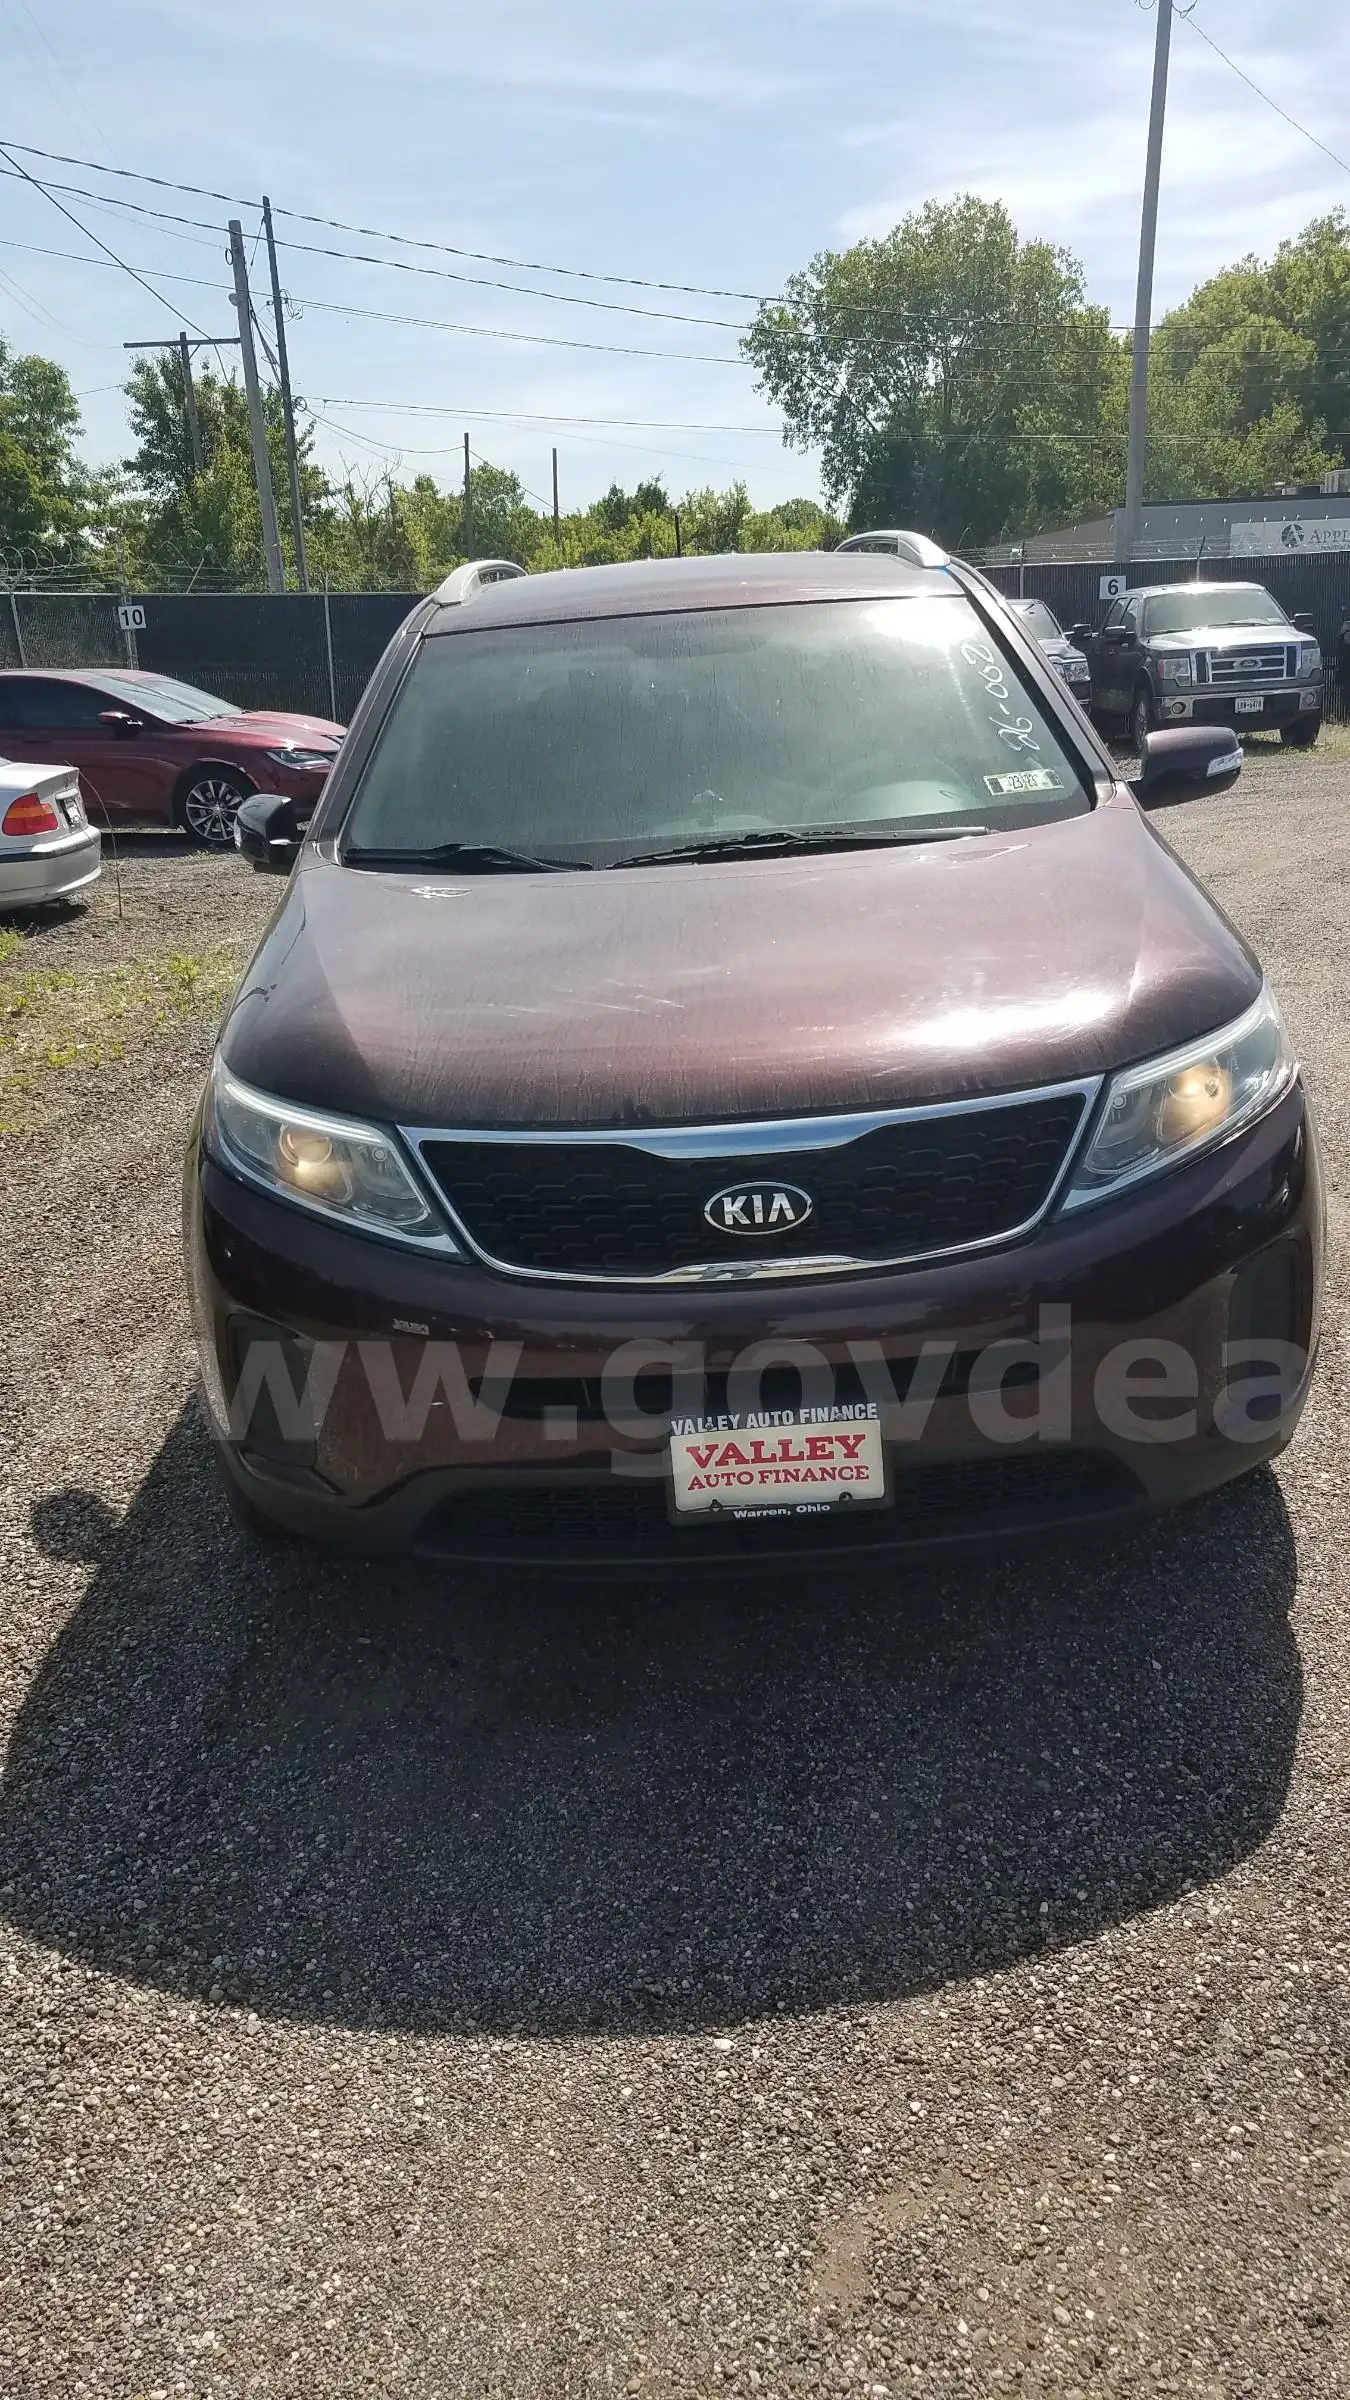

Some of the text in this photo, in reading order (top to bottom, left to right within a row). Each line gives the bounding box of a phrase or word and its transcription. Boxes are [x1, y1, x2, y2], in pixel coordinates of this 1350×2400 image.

[1107, 578, 1119, 596] 6
[121, 609, 143, 626] 10
[721, 1192, 796, 1225] KIA
[671, 1402, 878, 1436] VALLEY AUTO FINANCE
[685, 1433, 867, 1470] VALLEY
[687, 1465, 870, 1492] AUTO FINANCE
[733, 1503, 831, 1520] Warren, Ohio
